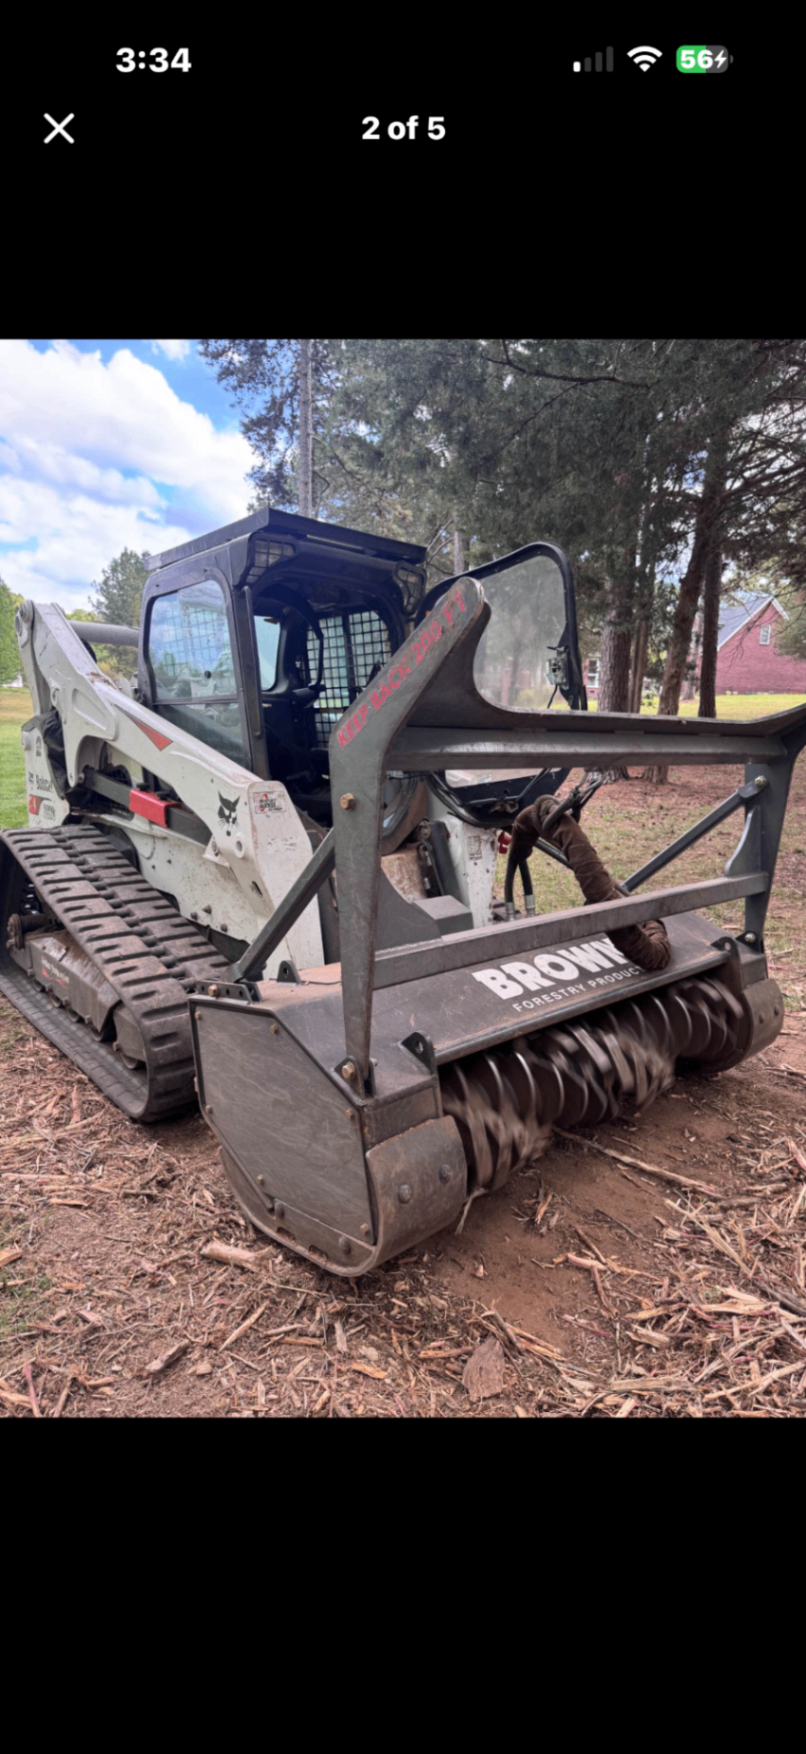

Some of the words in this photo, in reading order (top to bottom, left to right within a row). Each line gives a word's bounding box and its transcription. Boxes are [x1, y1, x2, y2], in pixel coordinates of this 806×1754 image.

[336, 704, 369, 749] KEEP
[369, 657, 412, 711] BACK
[410, 620, 443, 666] 200
[443, 592, 467, 627] FT
[471, 937, 629, 1000] BROWN
[512, 983, 587, 1013] FORESTRY
[587, 965, 646, 989] PRODUCT
